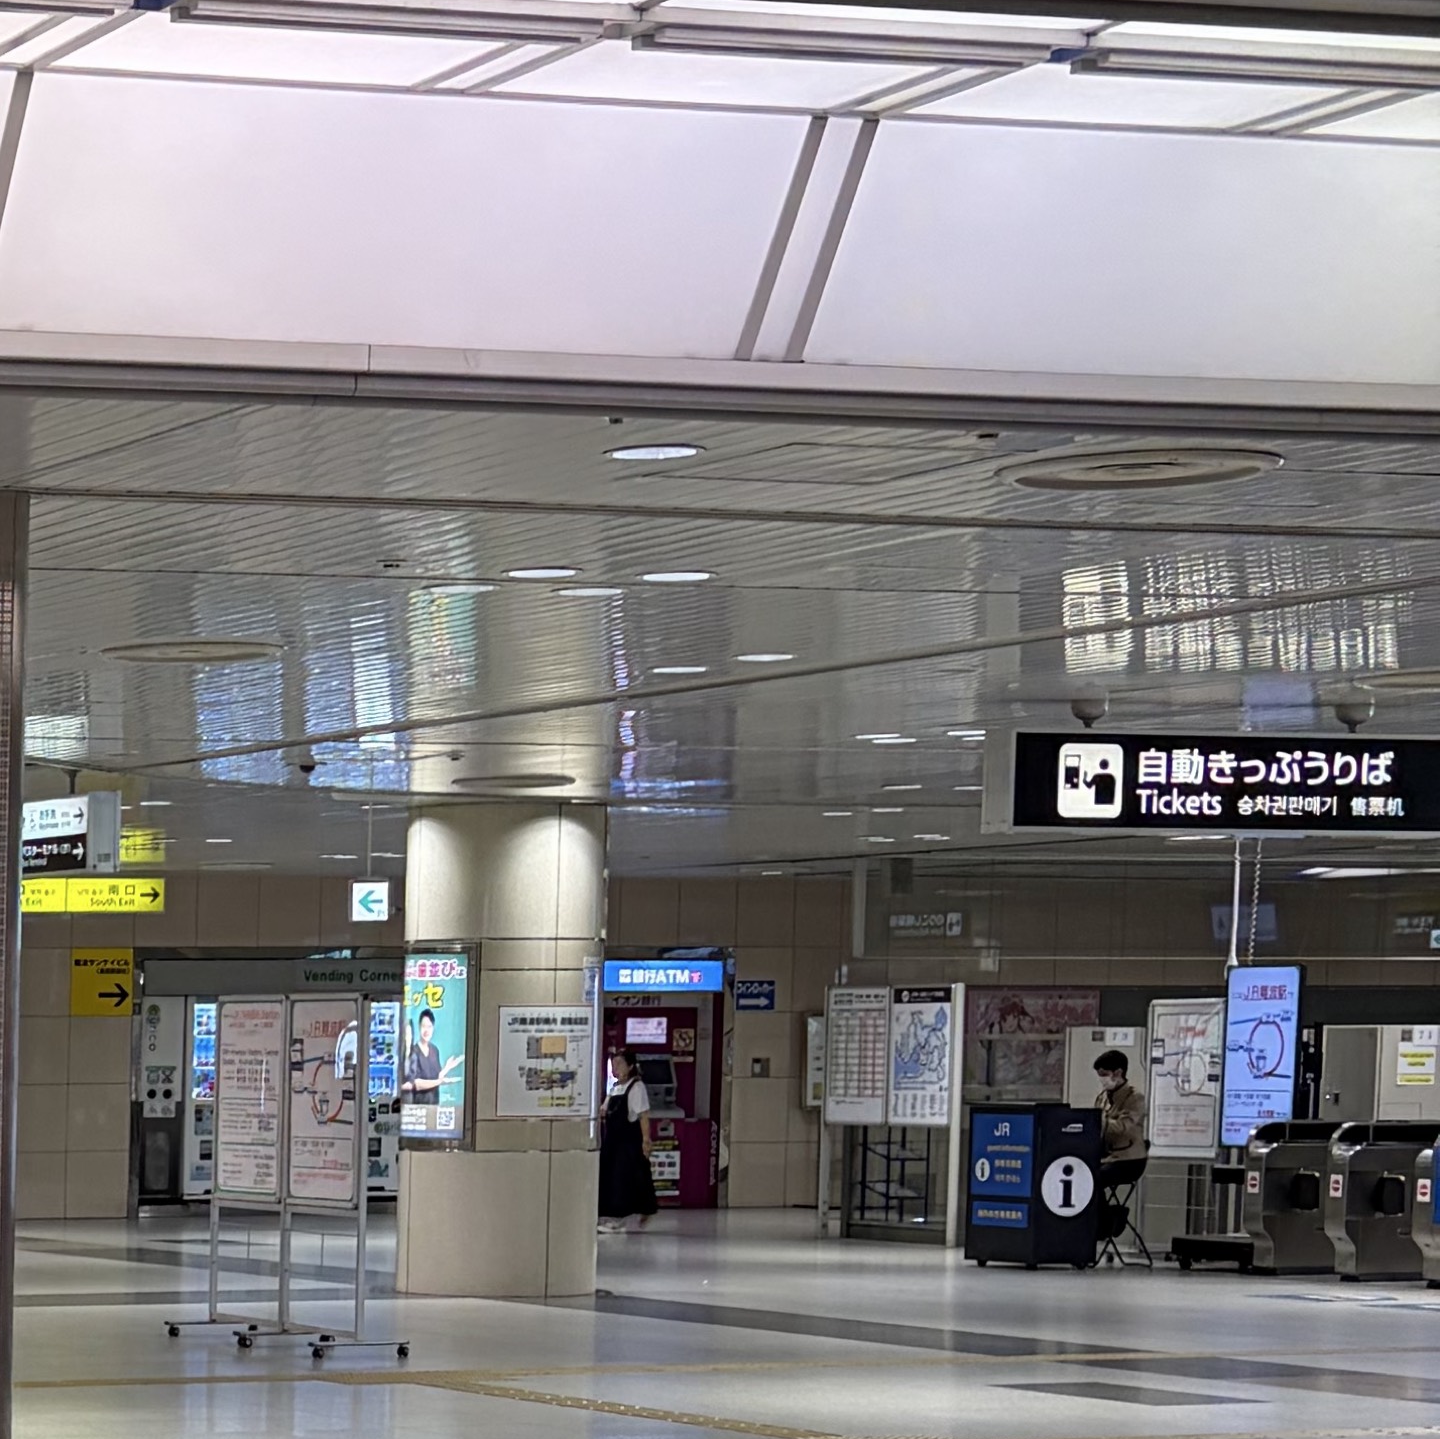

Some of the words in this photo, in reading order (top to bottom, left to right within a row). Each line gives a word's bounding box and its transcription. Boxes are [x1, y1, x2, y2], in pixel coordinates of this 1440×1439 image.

[1138, 748, 1395, 785] 自動きっぷうりば
[1136, 788, 1222, 815] Tickets
[1237, 795, 1338, 816] 승차권판매기
[1350, 797, 1405, 816] 售票机
[303, 969, 354, 983] Vending
[359, 969, 402, 982] Corne
